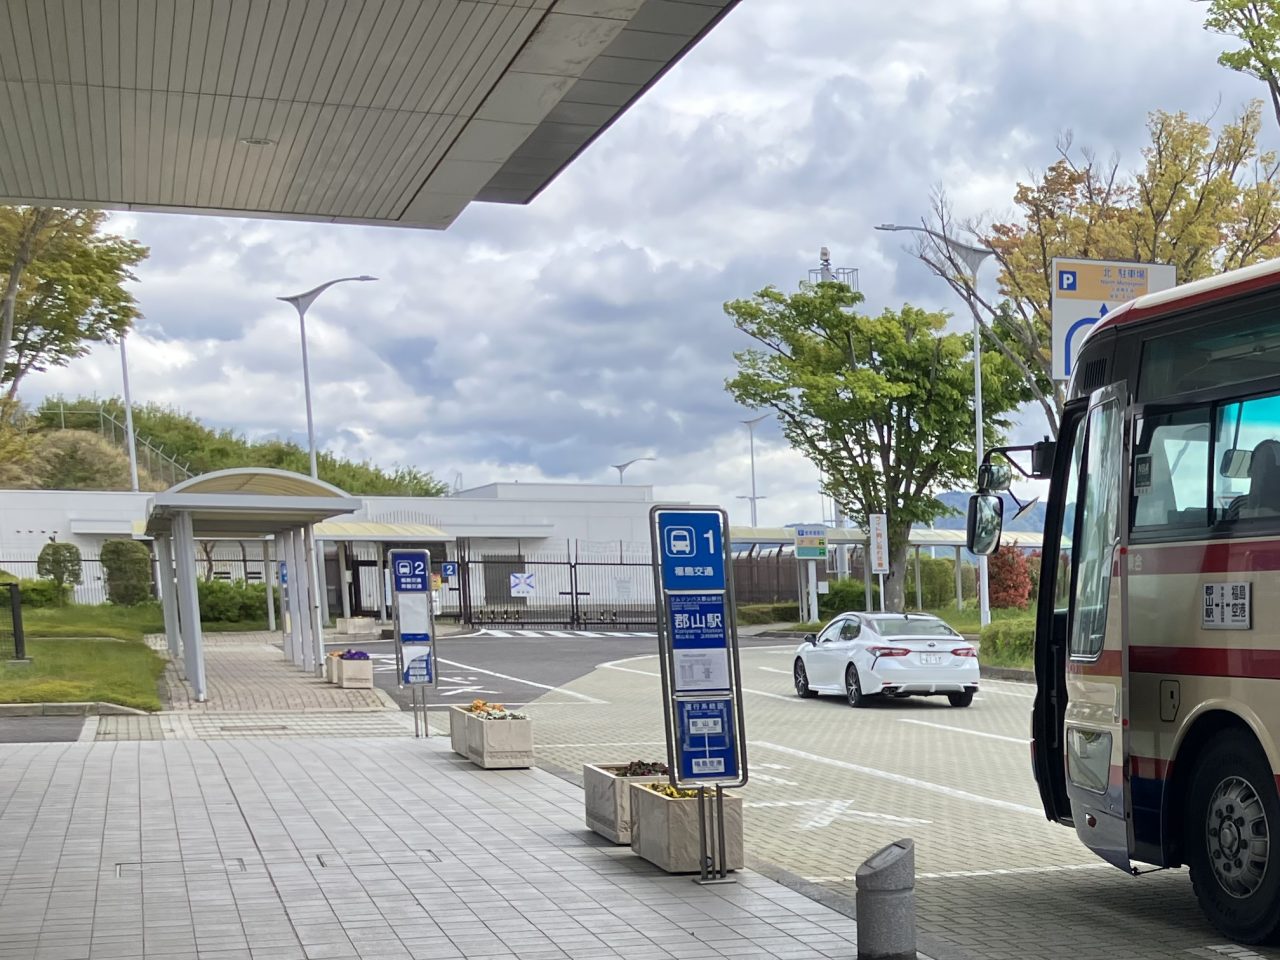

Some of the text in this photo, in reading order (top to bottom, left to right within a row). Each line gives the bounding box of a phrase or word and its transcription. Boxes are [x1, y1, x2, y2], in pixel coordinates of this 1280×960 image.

[703, 529, 715, 555] 1
[414, 561, 425, 575] 2
[446, 565, 454, 575] 2
[1205, 585, 1214, 619] 郡山駅
[674, 612, 723, 629] 郡山駅
